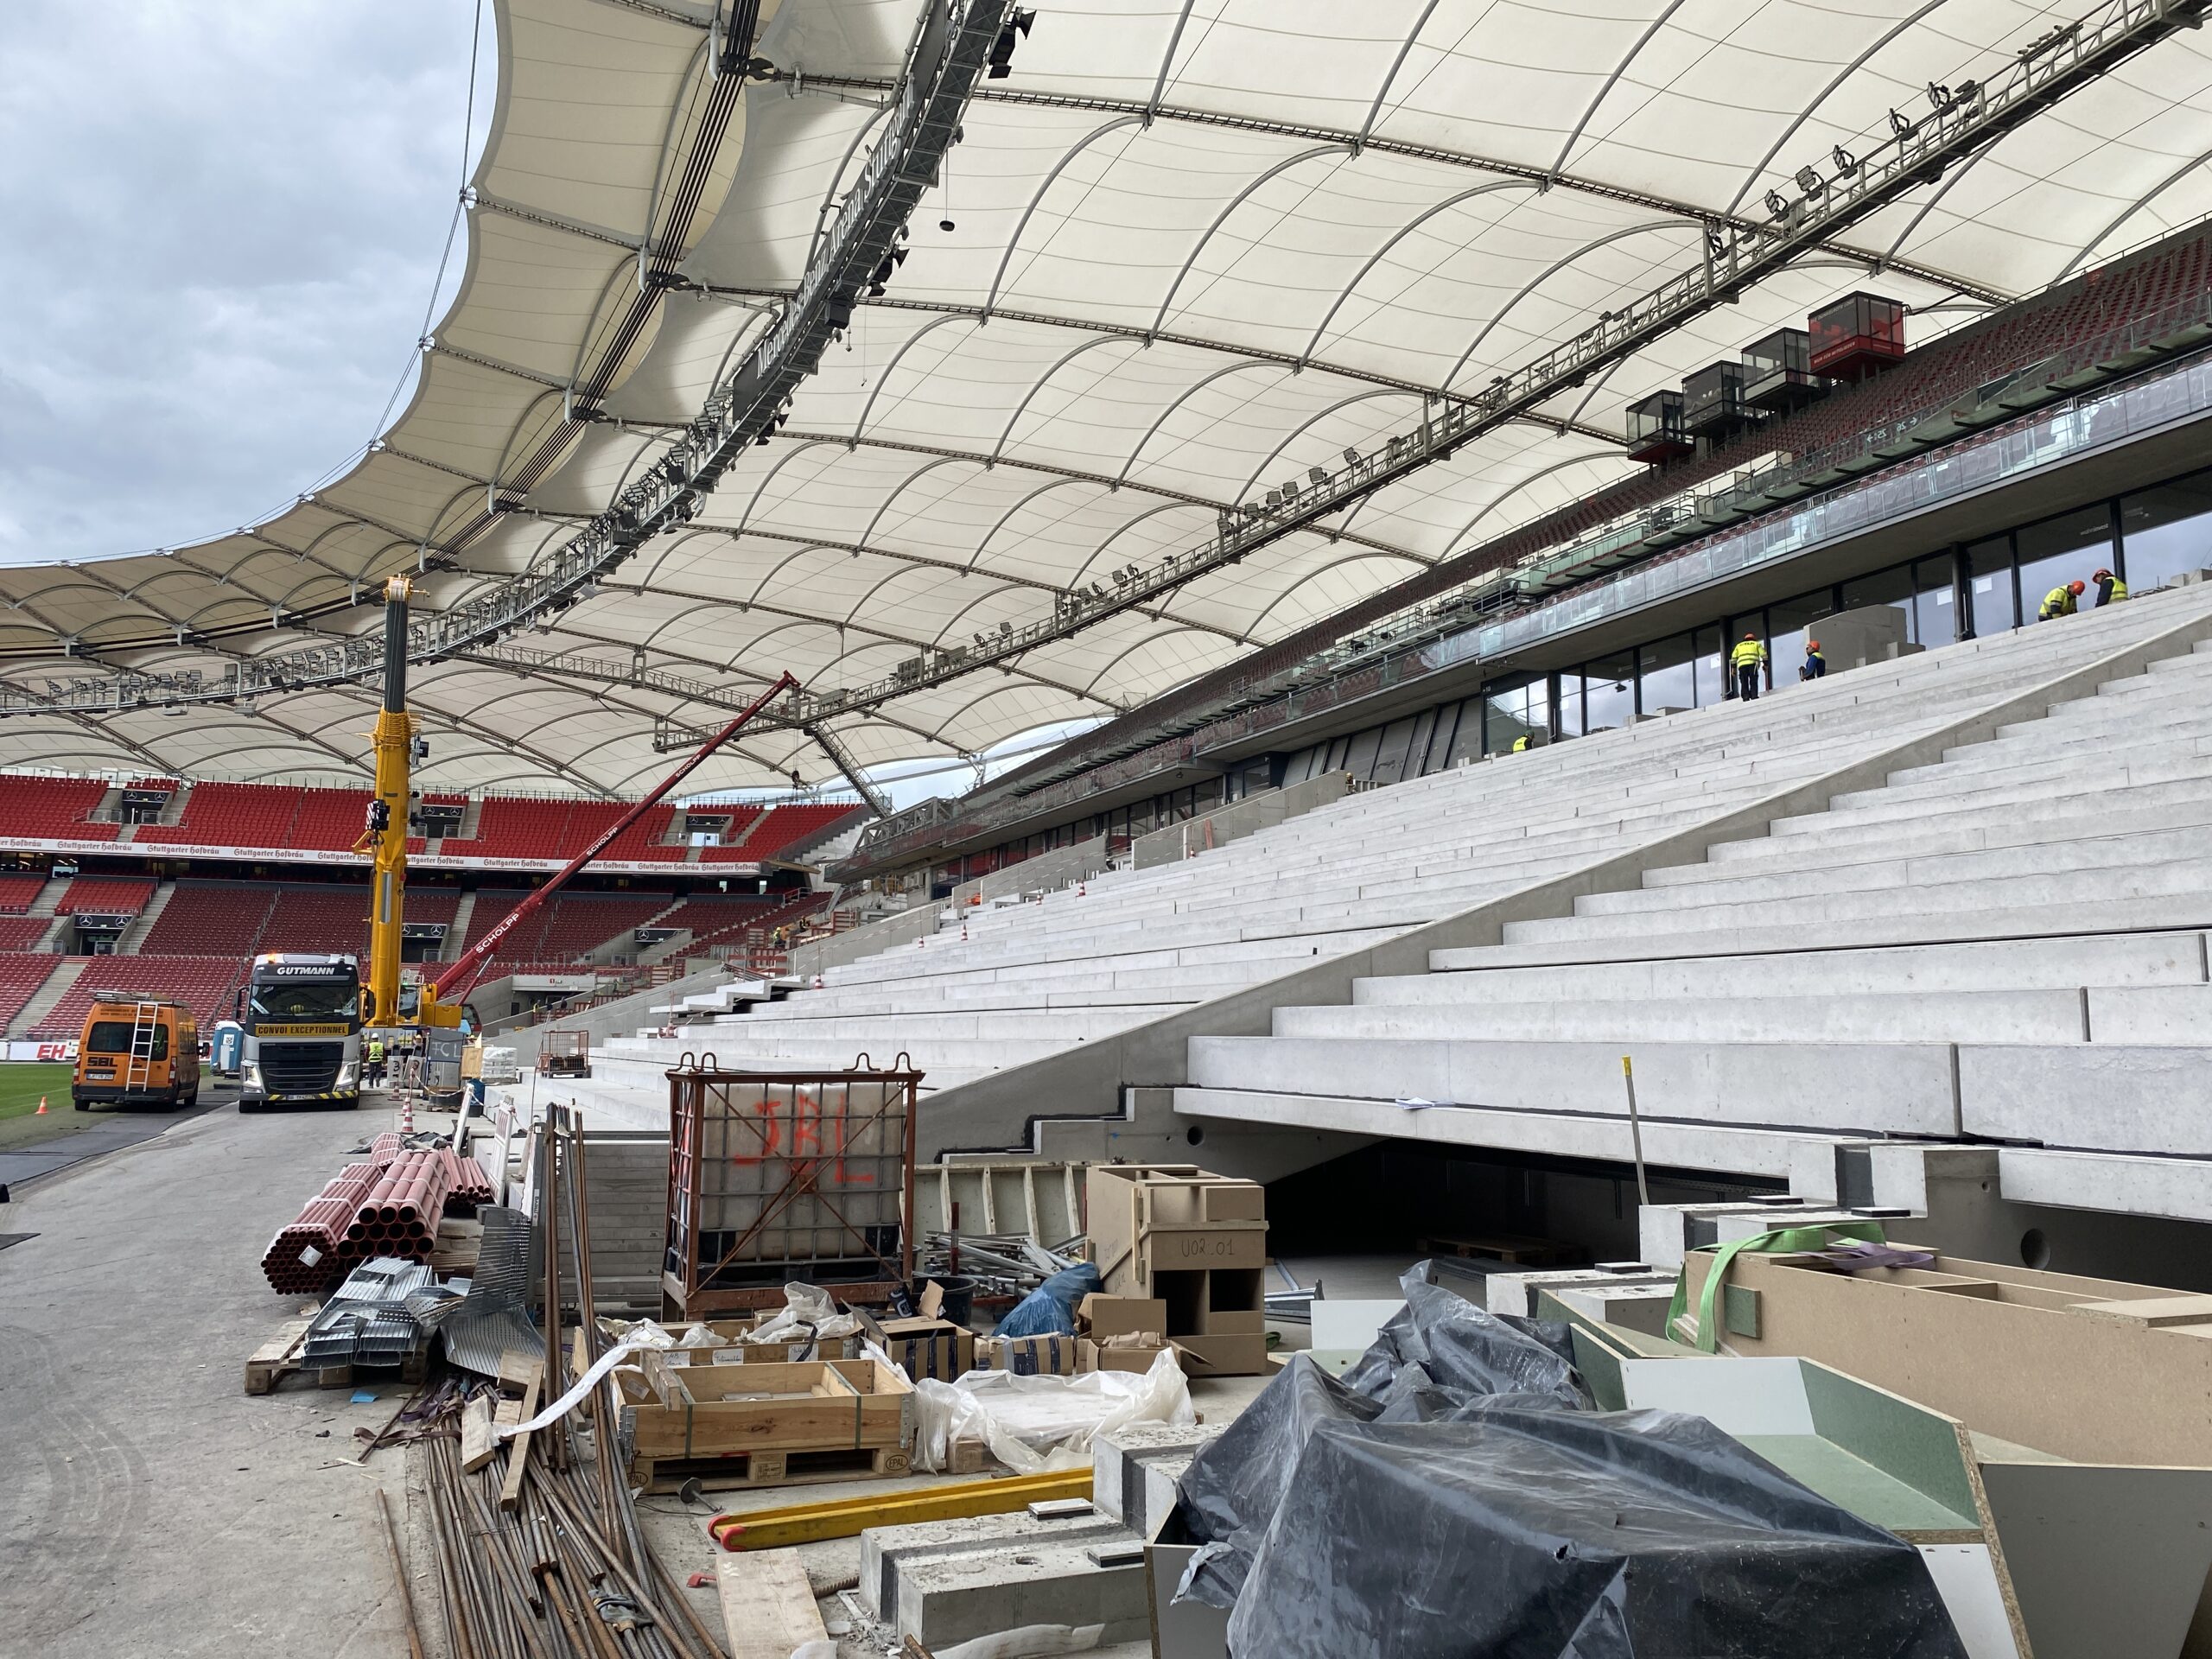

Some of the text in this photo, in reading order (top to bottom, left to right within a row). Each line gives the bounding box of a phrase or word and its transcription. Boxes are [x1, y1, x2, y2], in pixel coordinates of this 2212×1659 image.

[675, 753, 702, 779] SCHOLPP
[57, 841, 132, 852] Stuttgarter Hofbräu
[586, 826, 619, 856] SCHOLPP
[147, 844, 220, 855] Stuttgarter Hofbräu
[233, 848, 304, 859] Stuttgarter Hofbräu
[317, 851, 356, 861] Stuttgarter
[436, 857, 464, 867] Hofbräu
[483, 858, 548, 868] Stuttgarter Hofbräu
[475, 912, 519, 954] SCHOLPP
[276, 966, 335, 976] GUTMANN
[257, 1026, 346, 1035] CONVOI EXCEPTIONNEL
[887, 1456, 907, 1469] EPAL
[628, 1474, 644, 1484] PAL
